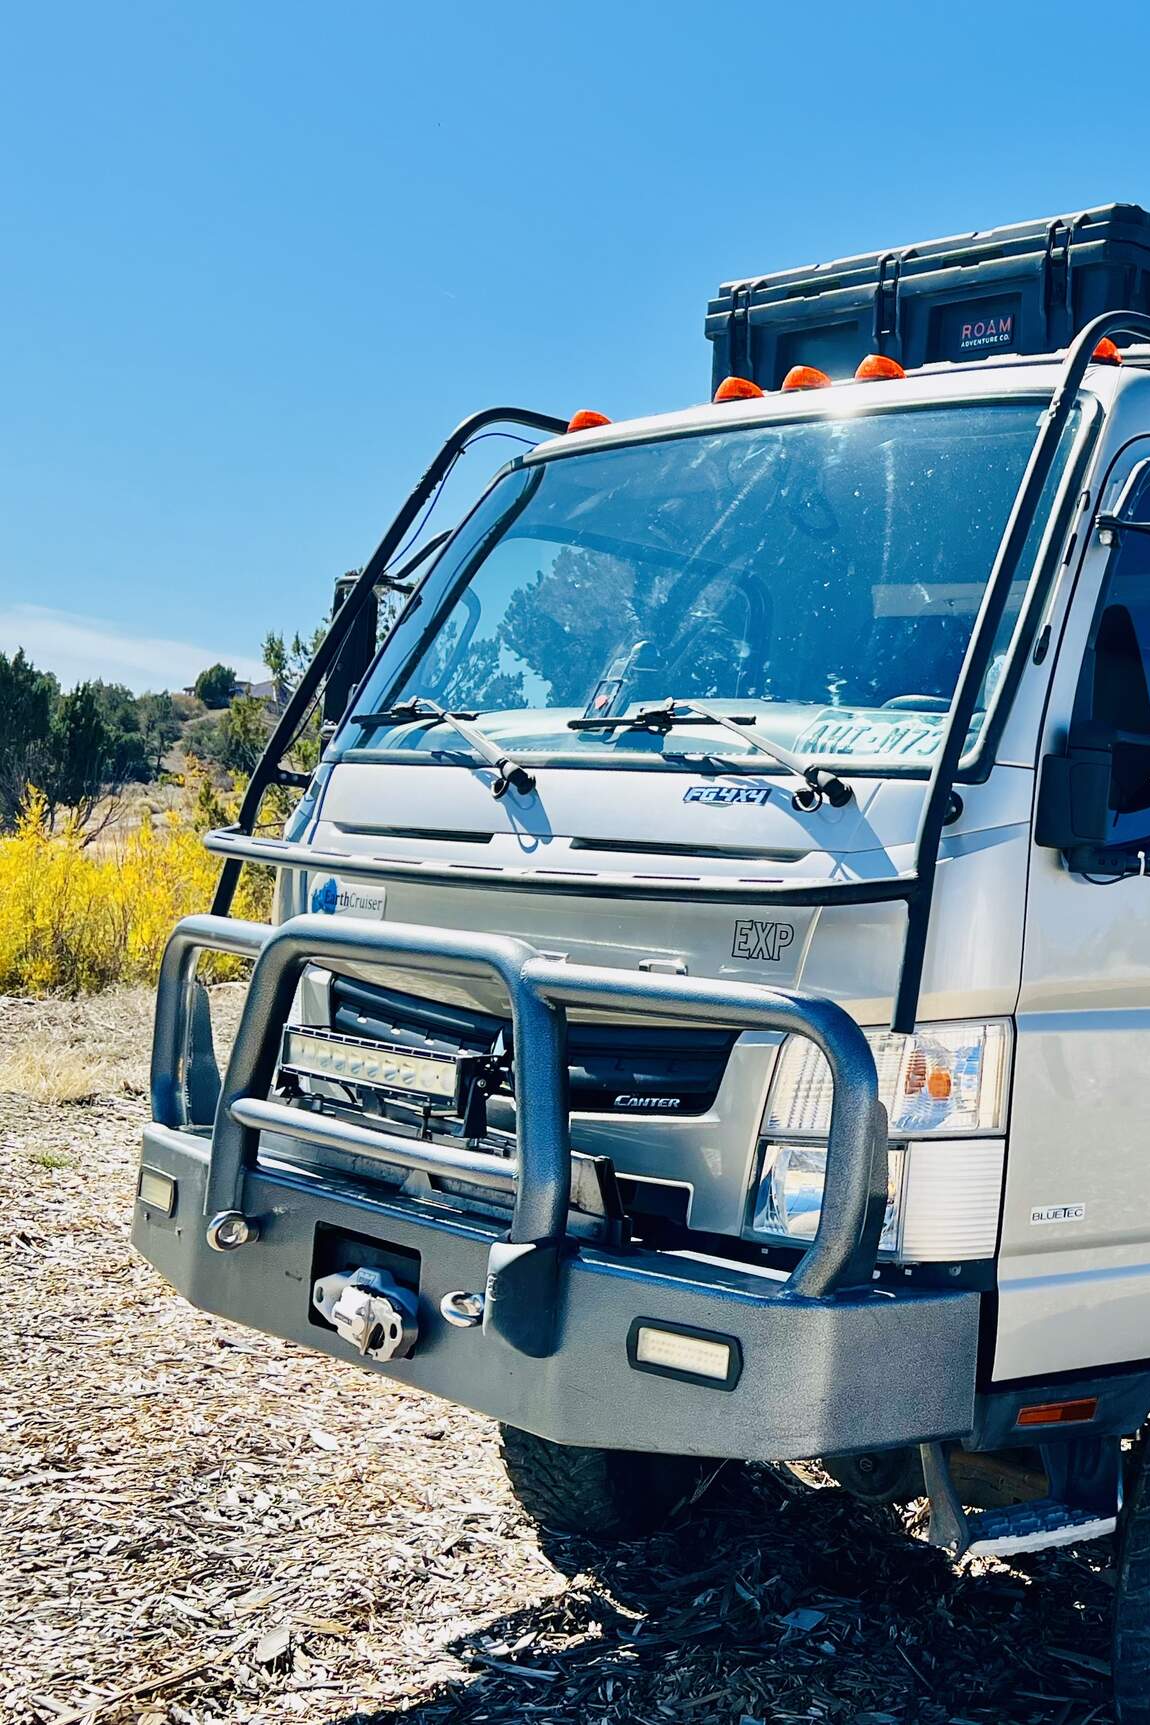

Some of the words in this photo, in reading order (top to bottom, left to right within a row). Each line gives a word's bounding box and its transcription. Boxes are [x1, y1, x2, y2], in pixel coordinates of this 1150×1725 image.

[961, 317, 1012, 340] ROAM
[960, 336, 998, 348] ADVENTURE
[999, 333, 1010, 342] CO.
[325, 889, 383, 911] EarthCruiser
[732, 919, 795, 961] EXP
